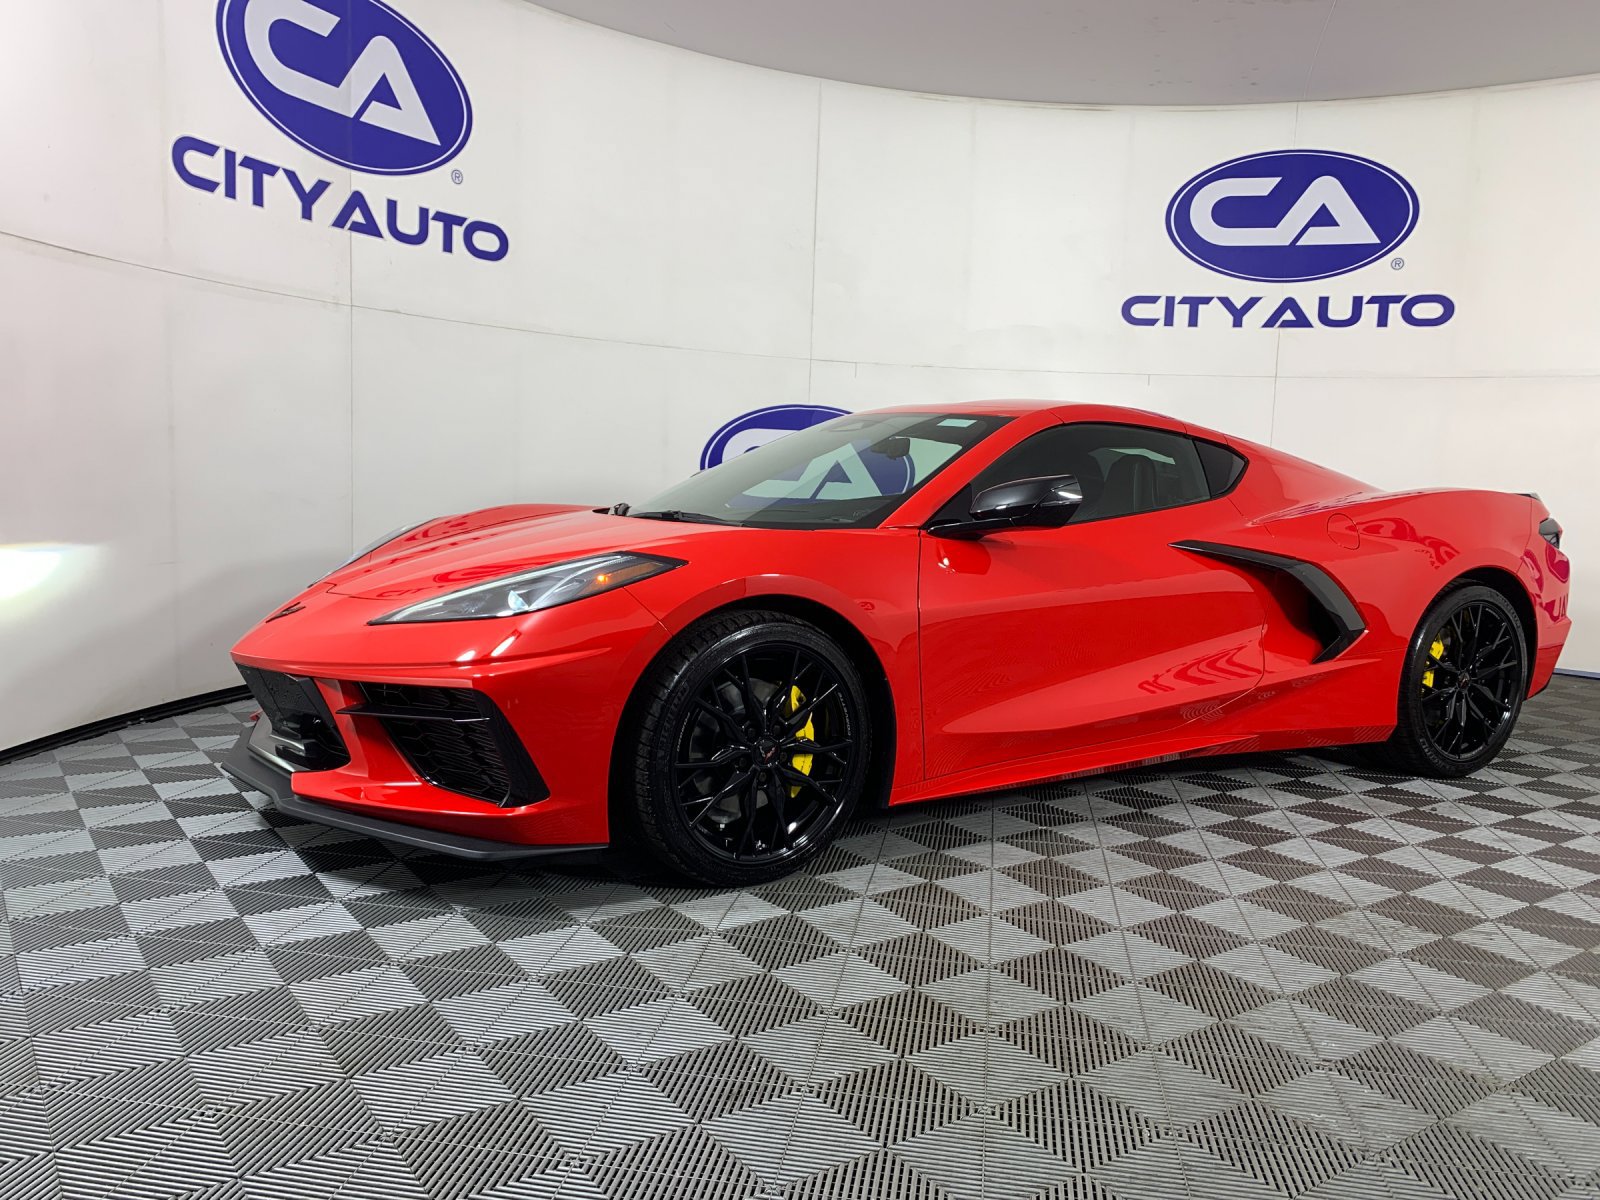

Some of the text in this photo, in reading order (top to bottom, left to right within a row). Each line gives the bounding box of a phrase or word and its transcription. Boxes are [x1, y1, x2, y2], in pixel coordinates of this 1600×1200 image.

[244, 0, 442, 146] CA
[172, 135, 509, 262] CITY AUTO
[1190, 175, 1381, 246] CA
[1121, 294, 1455, 328] CITY AUTO
